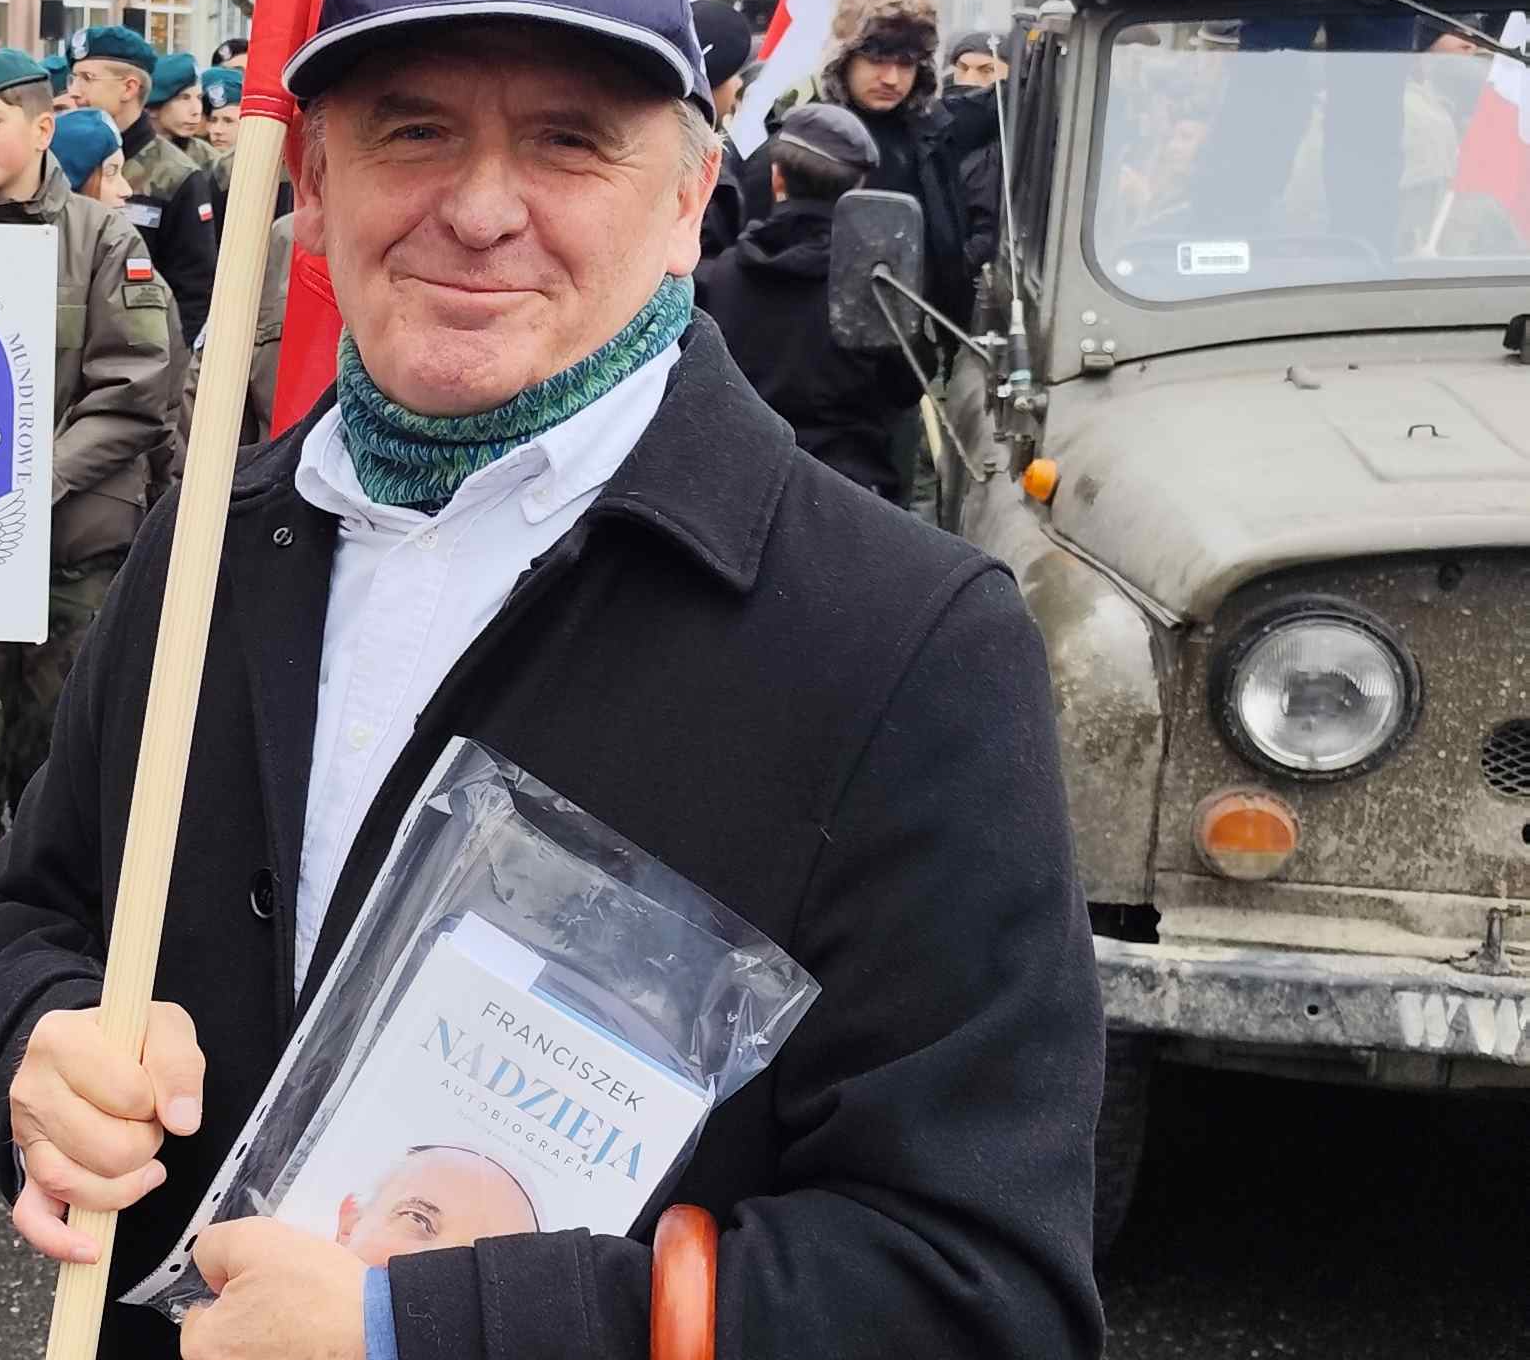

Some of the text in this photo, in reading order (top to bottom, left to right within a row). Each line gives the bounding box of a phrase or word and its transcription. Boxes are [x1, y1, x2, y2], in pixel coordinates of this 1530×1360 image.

[6, 332, 34, 485] MUNDUROWE
[419, 1013, 643, 1182] NADZIEJA
[480, 1000, 645, 1113] FRANCISZEK
[440, 1078, 595, 1181] AUTOBIOGRAFIA
